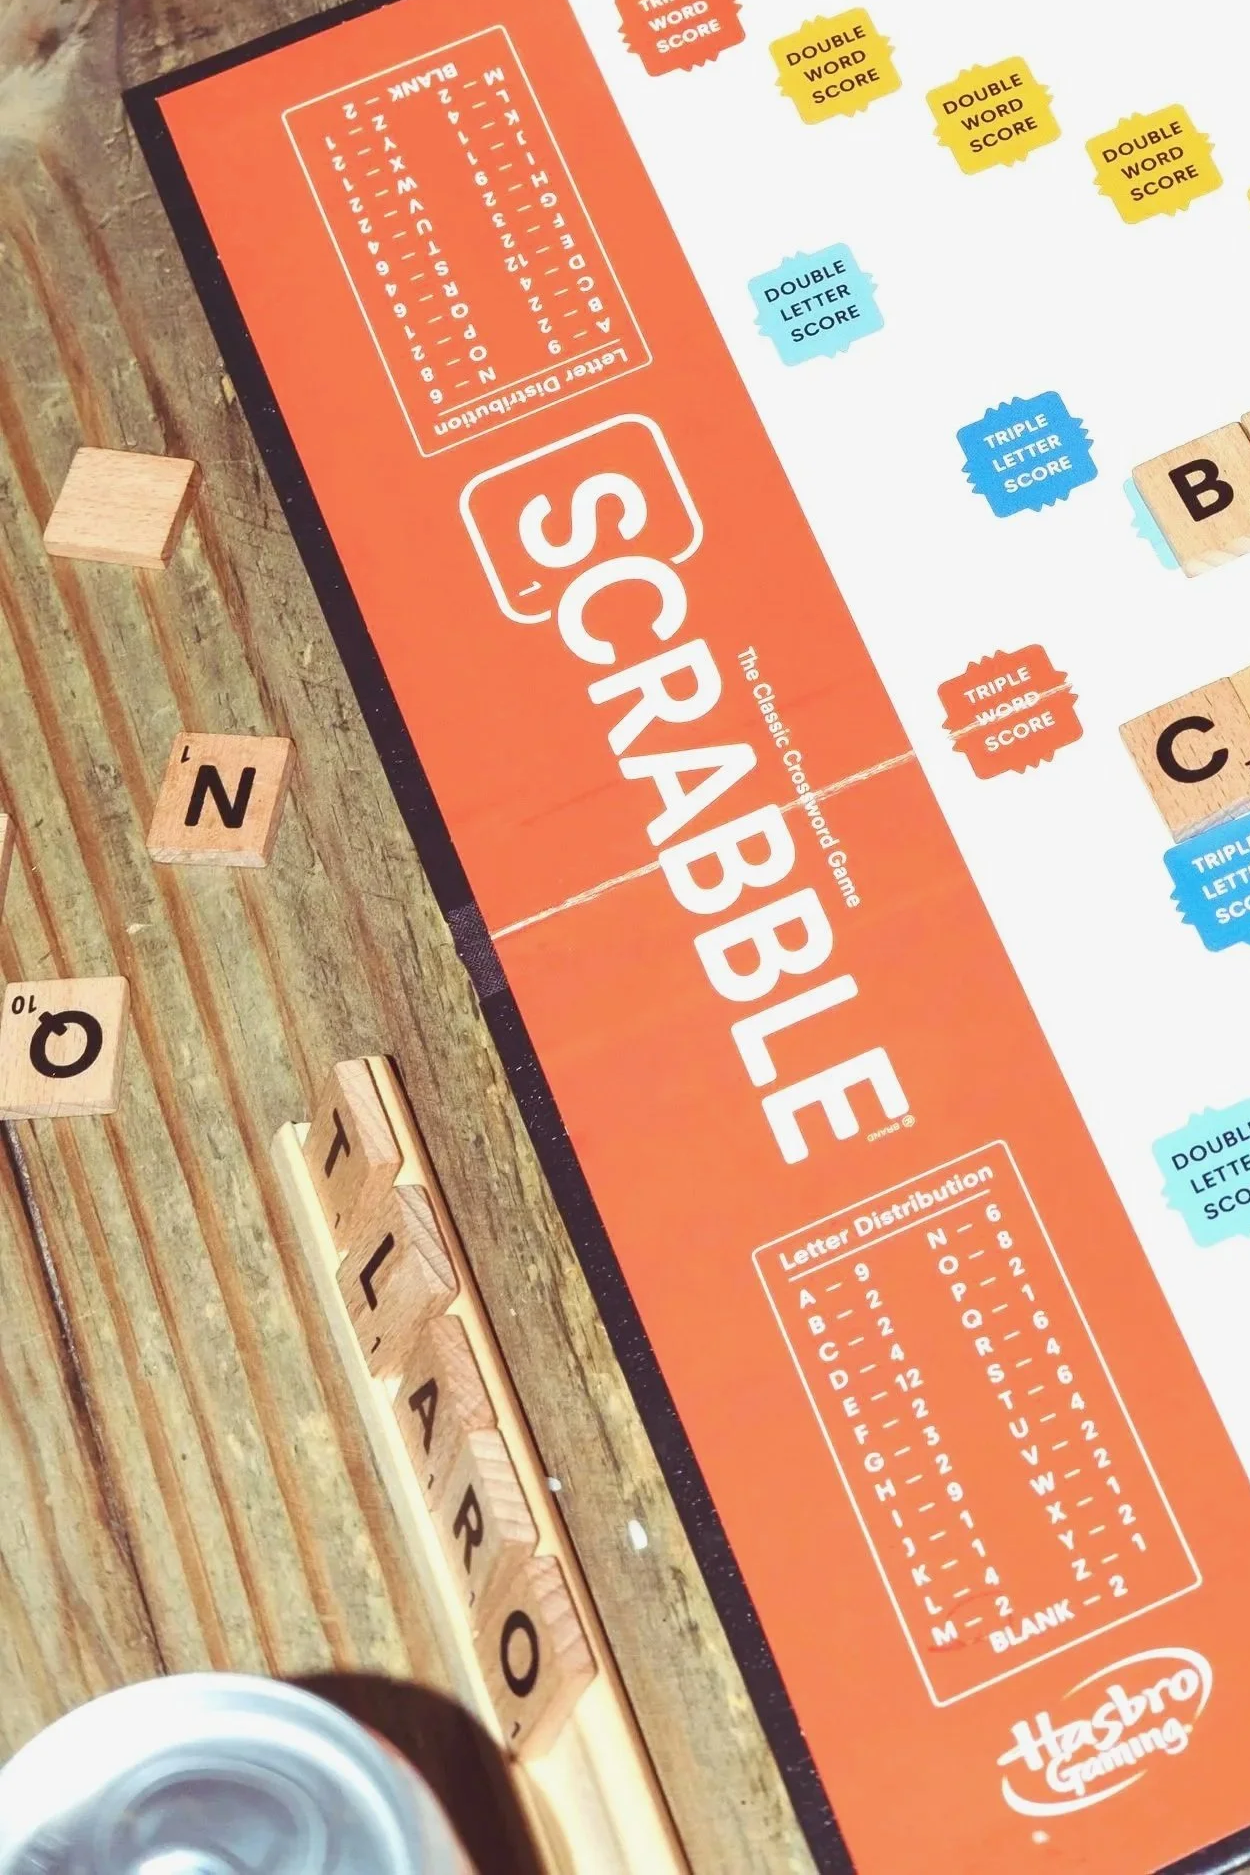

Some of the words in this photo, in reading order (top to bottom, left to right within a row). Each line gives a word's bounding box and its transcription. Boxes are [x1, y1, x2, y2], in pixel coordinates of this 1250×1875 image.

[647, 0, 709, 33] WORD
[654, 17, 721, 55] SCORE
[786, 25, 866, 67] DOUBLE
[803, 50, 866, 82] WORD
[388, 61, 459, 103] BLANK
[812, 68, 880, 104] SCORE
[942, 73, 1023, 115] DOUBLE
[960, 98, 1023, 131] WORD
[969, 116, 1038, 153] SCORE
[764, 259, 846, 303] DOUBLE
[780, 284, 851, 322] LETTER
[790, 304, 861, 343] SCORE
[565, 346, 629, 385] Letter
[433, 374, 562, 437] Distribution
[984, 413, 1048, 447] TRIPLE
[991, 433, 1062, 473] LETTER
[1003, 455, 1072, 493] SCORE
[736, 645, 761, 683] The
[752, 681, 792, 750] Classic
[781, 748, 841, 850] Crossword
[826, 849, 862, 910] Game
[517, 470, 912, 1166] SCRABBLE
[777, 1226, 851, 1273] Letter
[853, 1162, 996, 1239] Distribution
[988, 1597, 1076, 1655] BLANK
[996, 1667, 1202, 1771] Hasbro
[1045, 1716, 1190, 1797] Gaming
